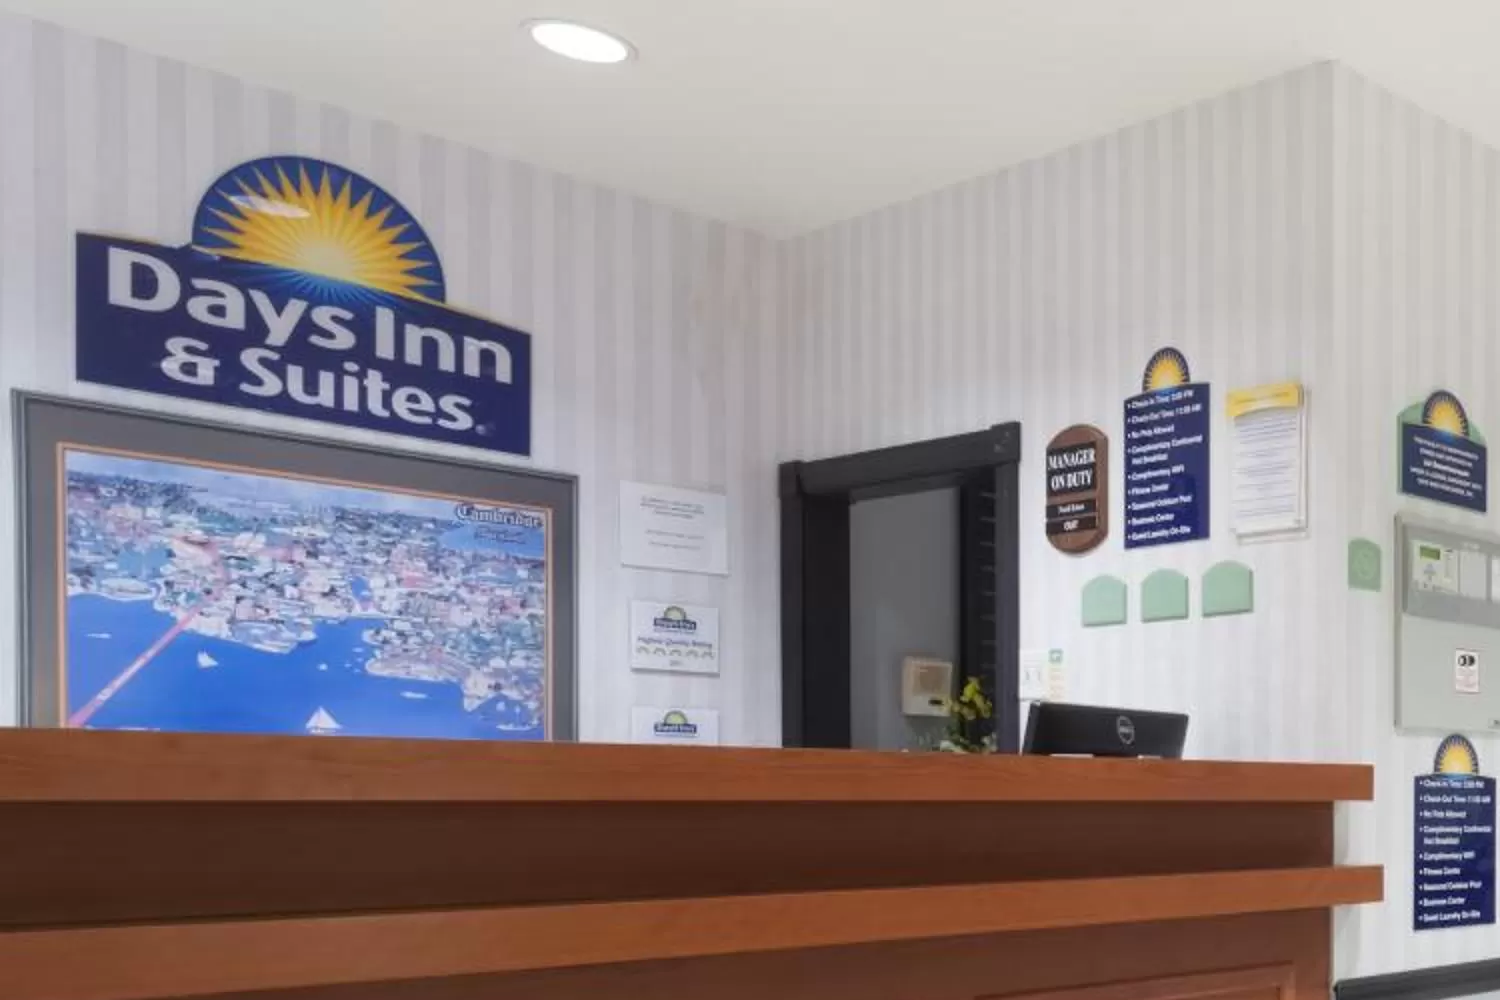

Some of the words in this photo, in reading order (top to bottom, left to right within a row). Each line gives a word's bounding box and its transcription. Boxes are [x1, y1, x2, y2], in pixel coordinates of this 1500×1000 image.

[107, 246, 355, 350] Days
[375, 306, 513, 384] Inn
[160, 336, 220, 386] &
[239, 347, 474, 432] Suites
[1153, 424, 1175, 434] Allowed
[1131, 441, 1171, 455] Complimentary
[1171, 434, 1203, 447] Continental
[1049, 448, 1096, 469] MANAGER
[1051, 475, 1065, 491] ON
[1066, 470, 1093, 488] DUTY
[1131, 469, 1171, 481] Complimentary
[1179, 494, 1193, 503] Pool
[454, 503, 543, 529] Cambridge
